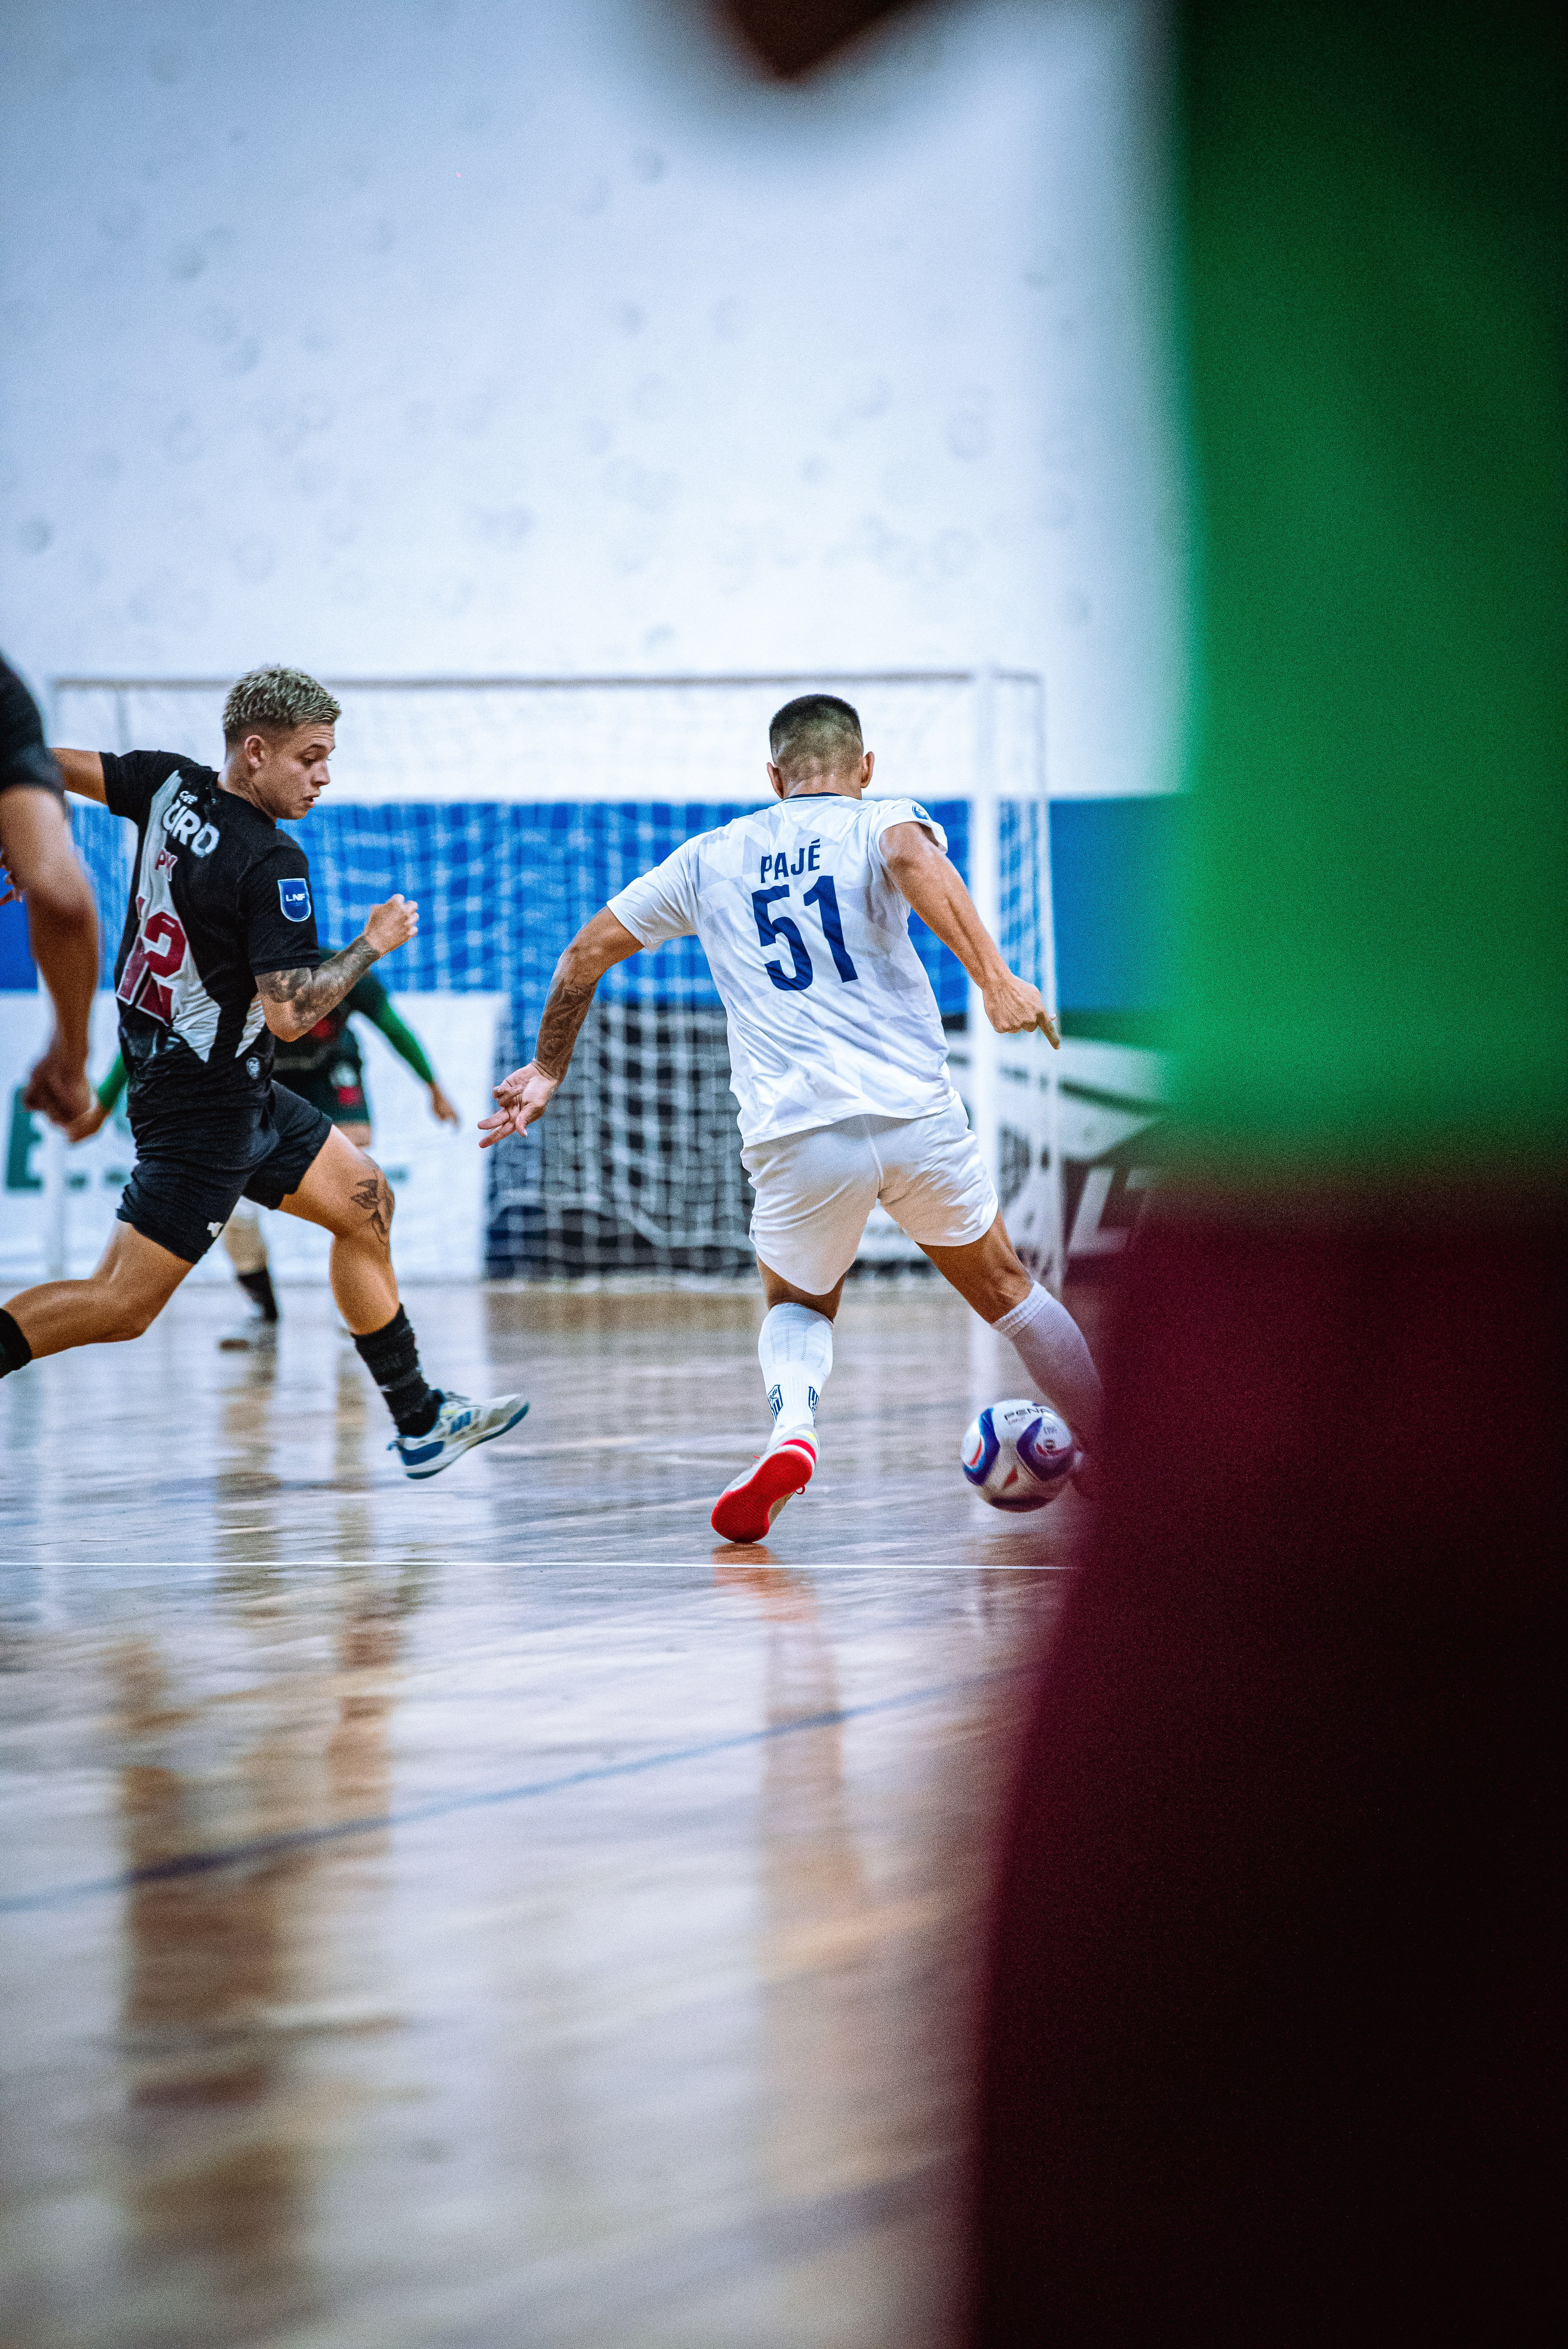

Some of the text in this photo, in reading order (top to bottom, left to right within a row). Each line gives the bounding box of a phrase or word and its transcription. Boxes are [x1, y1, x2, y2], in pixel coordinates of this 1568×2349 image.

[761, 838, 821, 883] PAJÉ
[285, 893, 306, 902] LNF
[751, 875, 859, 991] 51
